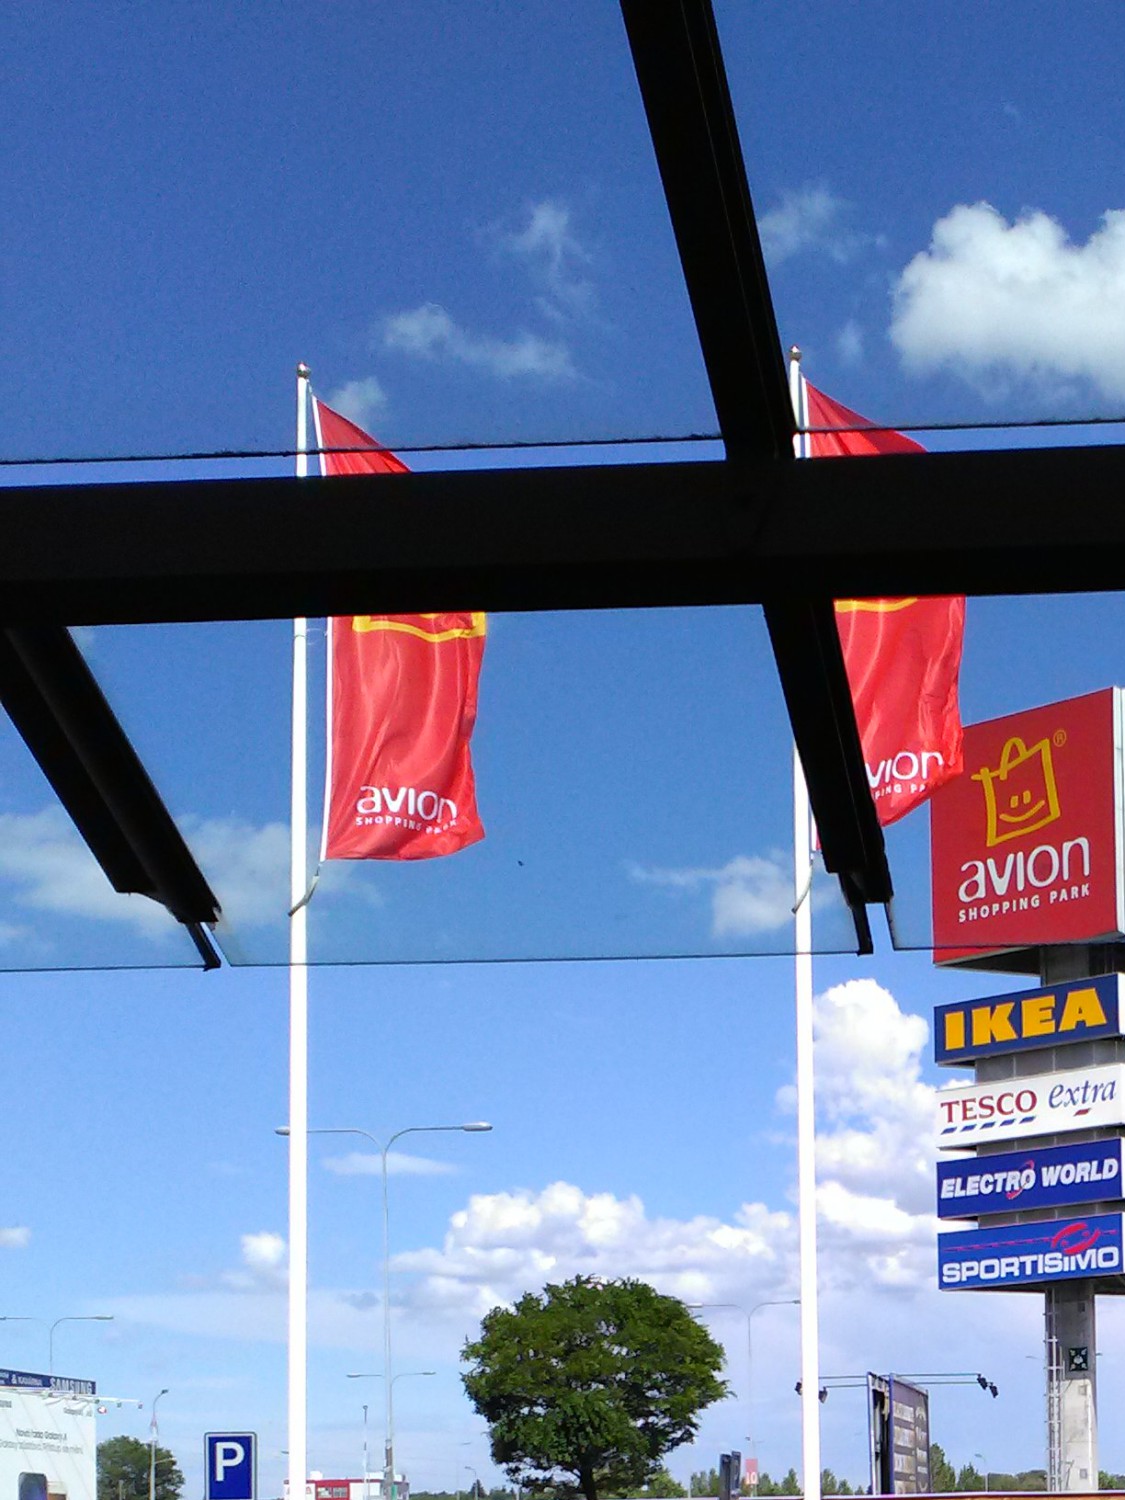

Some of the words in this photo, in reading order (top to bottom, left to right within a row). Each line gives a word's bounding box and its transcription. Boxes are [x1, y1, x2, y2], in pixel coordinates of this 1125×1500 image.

[865, 751, 944, 788] vion
[355, 816, 422, 831] SHOPPING
[356, 785, 458, 824] avion
[958, 837, 1089, 903] avion
[958, 897, 1041, 923] SHOPPING
[1049, 883, 1091, 904] PARK
[945, 988, 1106, 1050] IKEA
[941, 1090, 1037, 1123] TESCO
[1048, 1078, 1117, 1110] extra
[940, 1169, 1036, 1199] ELECTRO
[1041, 1158, 1119, 1188] WORLD
[49, 1377, 93, 1395] SAMSUNG
[215, 1441, 244, 1482] P
